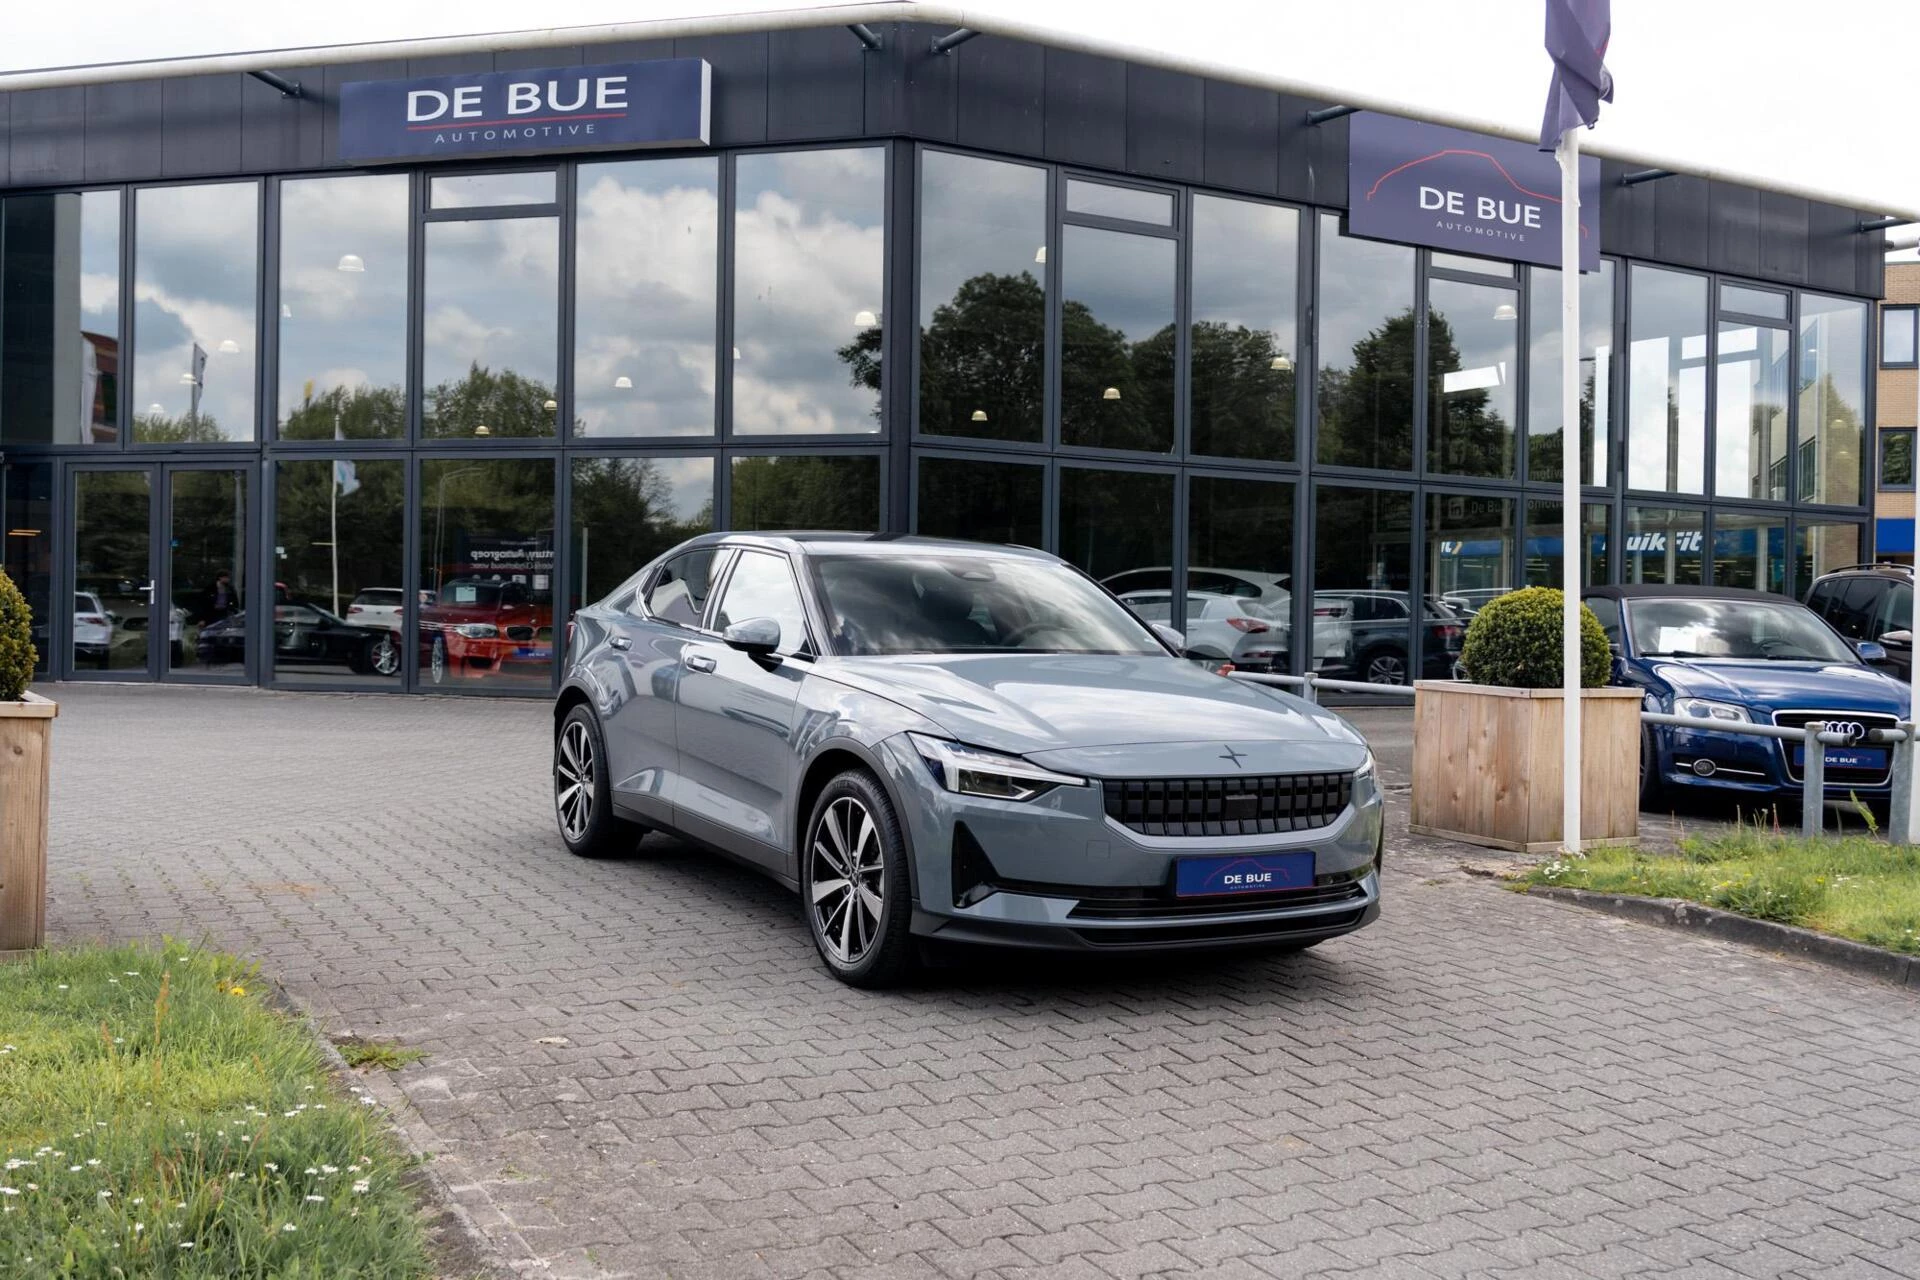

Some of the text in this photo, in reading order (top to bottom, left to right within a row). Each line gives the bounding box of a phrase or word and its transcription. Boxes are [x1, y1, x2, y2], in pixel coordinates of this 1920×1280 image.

[407, 76, 628, 122] DE BUE
[434, 124, 595, 144] AUTOMOTIVE
[1420, 186, 1541, 229] DE BUE
[1436, 220, 1525, 242] AUTOMOTIVE
[1224, 872, 1272, 884] DE BUE
